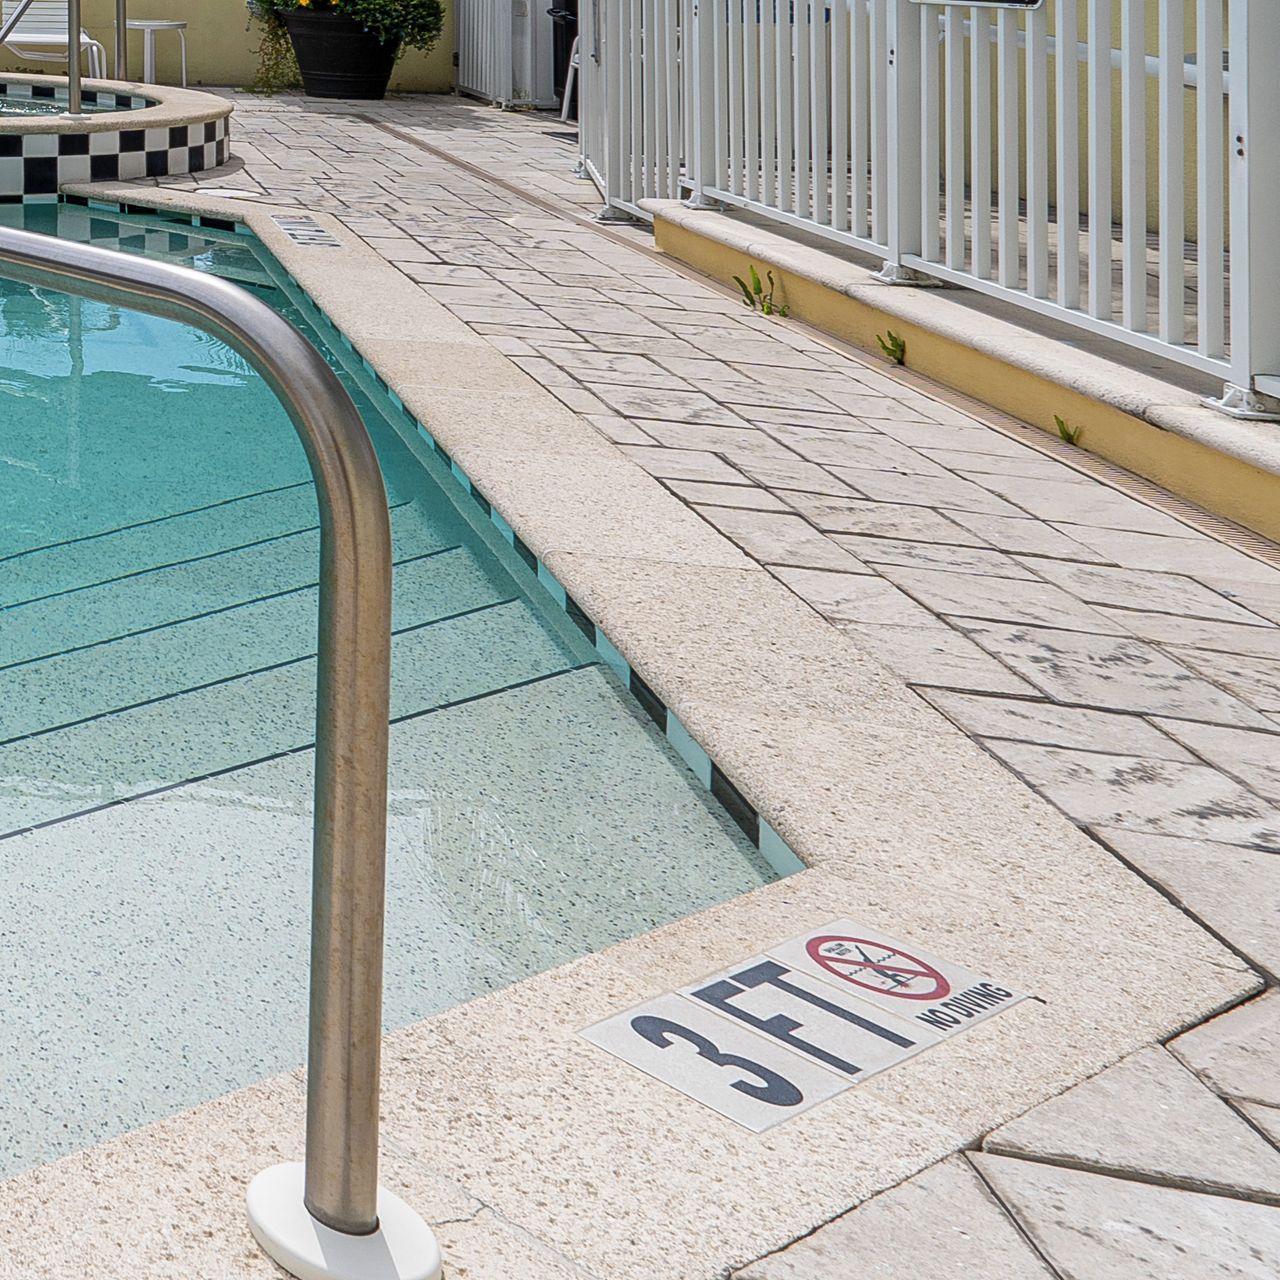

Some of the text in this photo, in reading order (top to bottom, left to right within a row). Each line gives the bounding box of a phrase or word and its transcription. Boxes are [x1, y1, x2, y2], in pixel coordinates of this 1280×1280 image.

[630, 960, 917, 1107] 3 FT
[914, 982, 1013, 1032] NO DIVING
